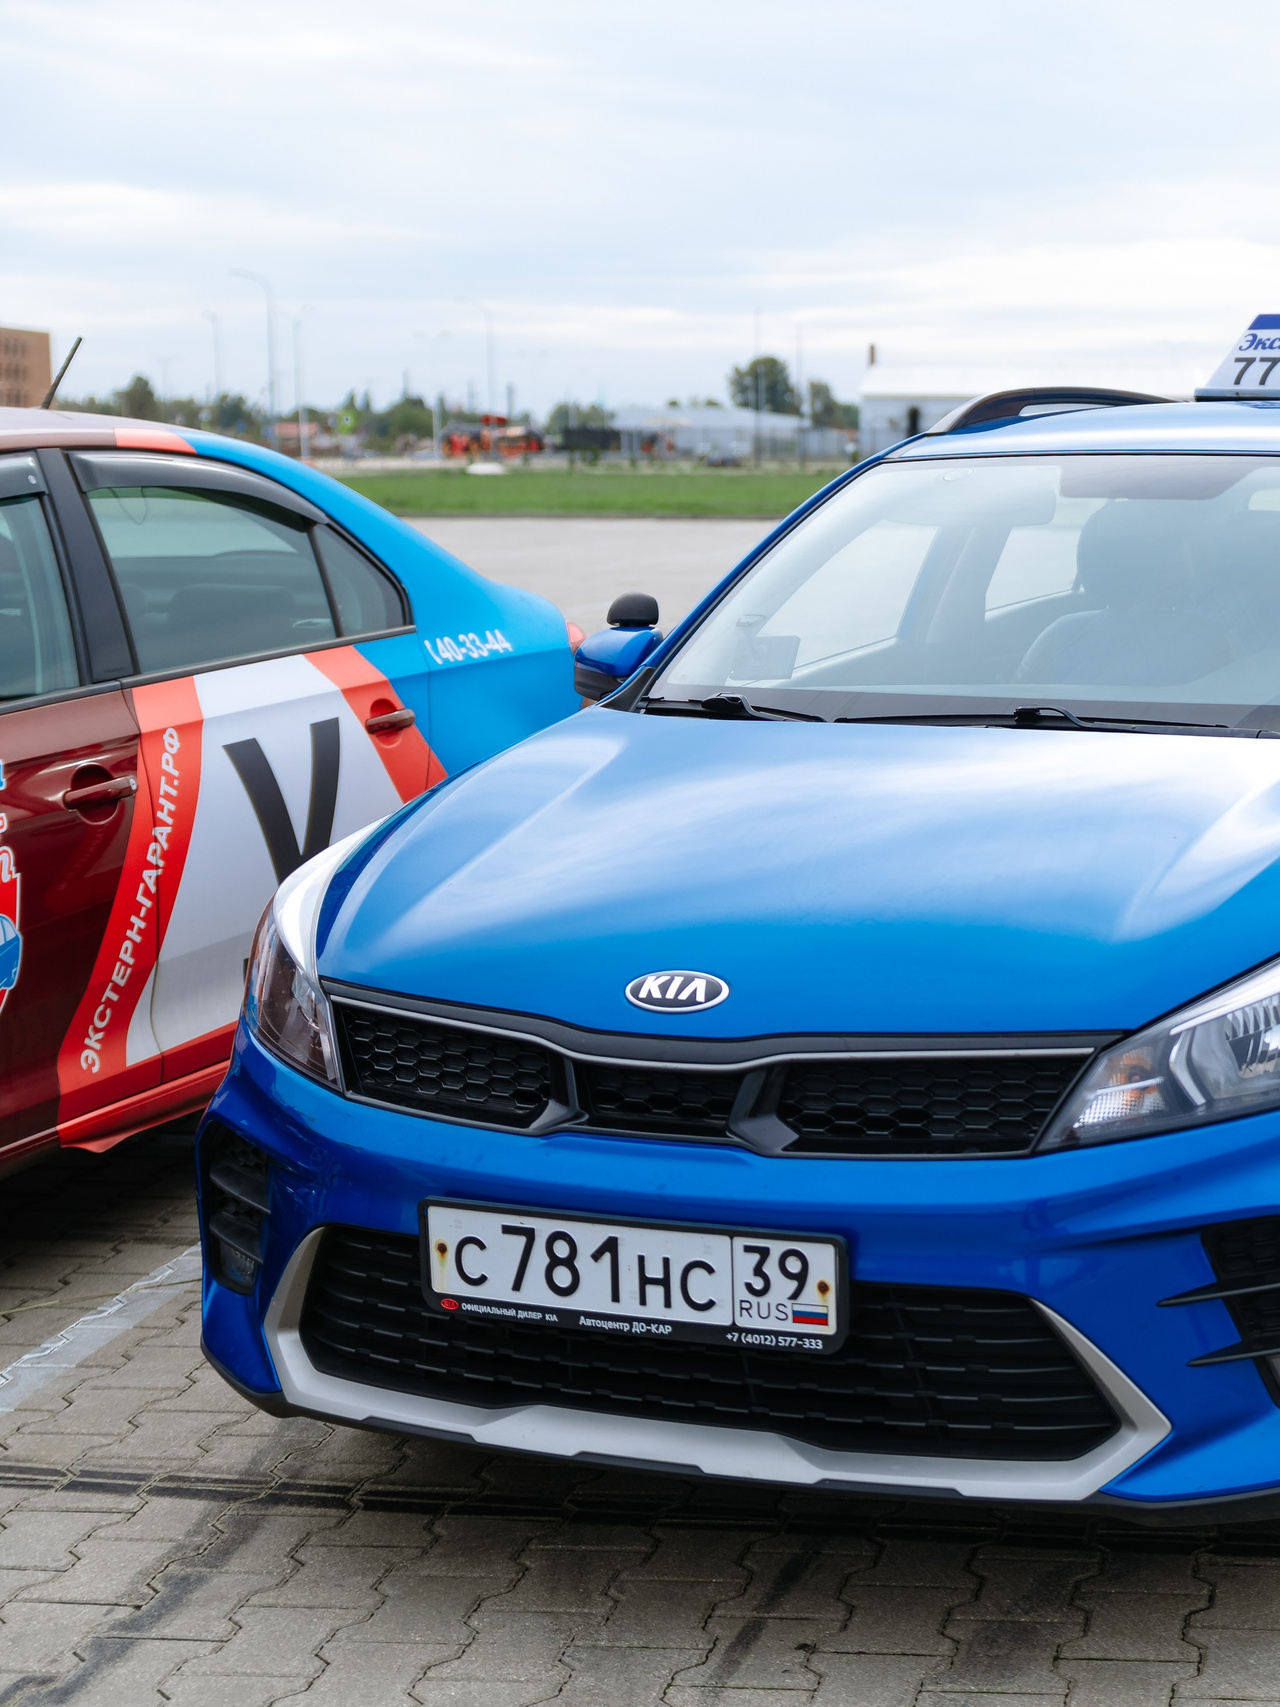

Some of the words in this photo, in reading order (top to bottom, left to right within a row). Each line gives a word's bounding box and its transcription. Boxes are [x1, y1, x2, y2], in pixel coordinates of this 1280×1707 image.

[80, 727, 180, 1074] ЭКСТЕРН-ГАРАНТ.РФ
[638, 975, 707, 1003] KIA
[742, 1244, 810, 1300] 39
[461, 1302, 517, 1318] ОФИЦИАЛЬНЫЙ
[517, 1310, 543, 1320] ДИЛЕР
[545, 1313, 559, 1322] KIA
[739, 1299, 789, 1321] RUS
[579, 1315, 630, 1332] Автоцентр
[631, 1322, 673, 1335] ДО-КАР
[725, 1332, 739, 1342] +7
[741, 1333, 777, 1346] (4012)
[777, 1337, 823, 1350] 577-333
